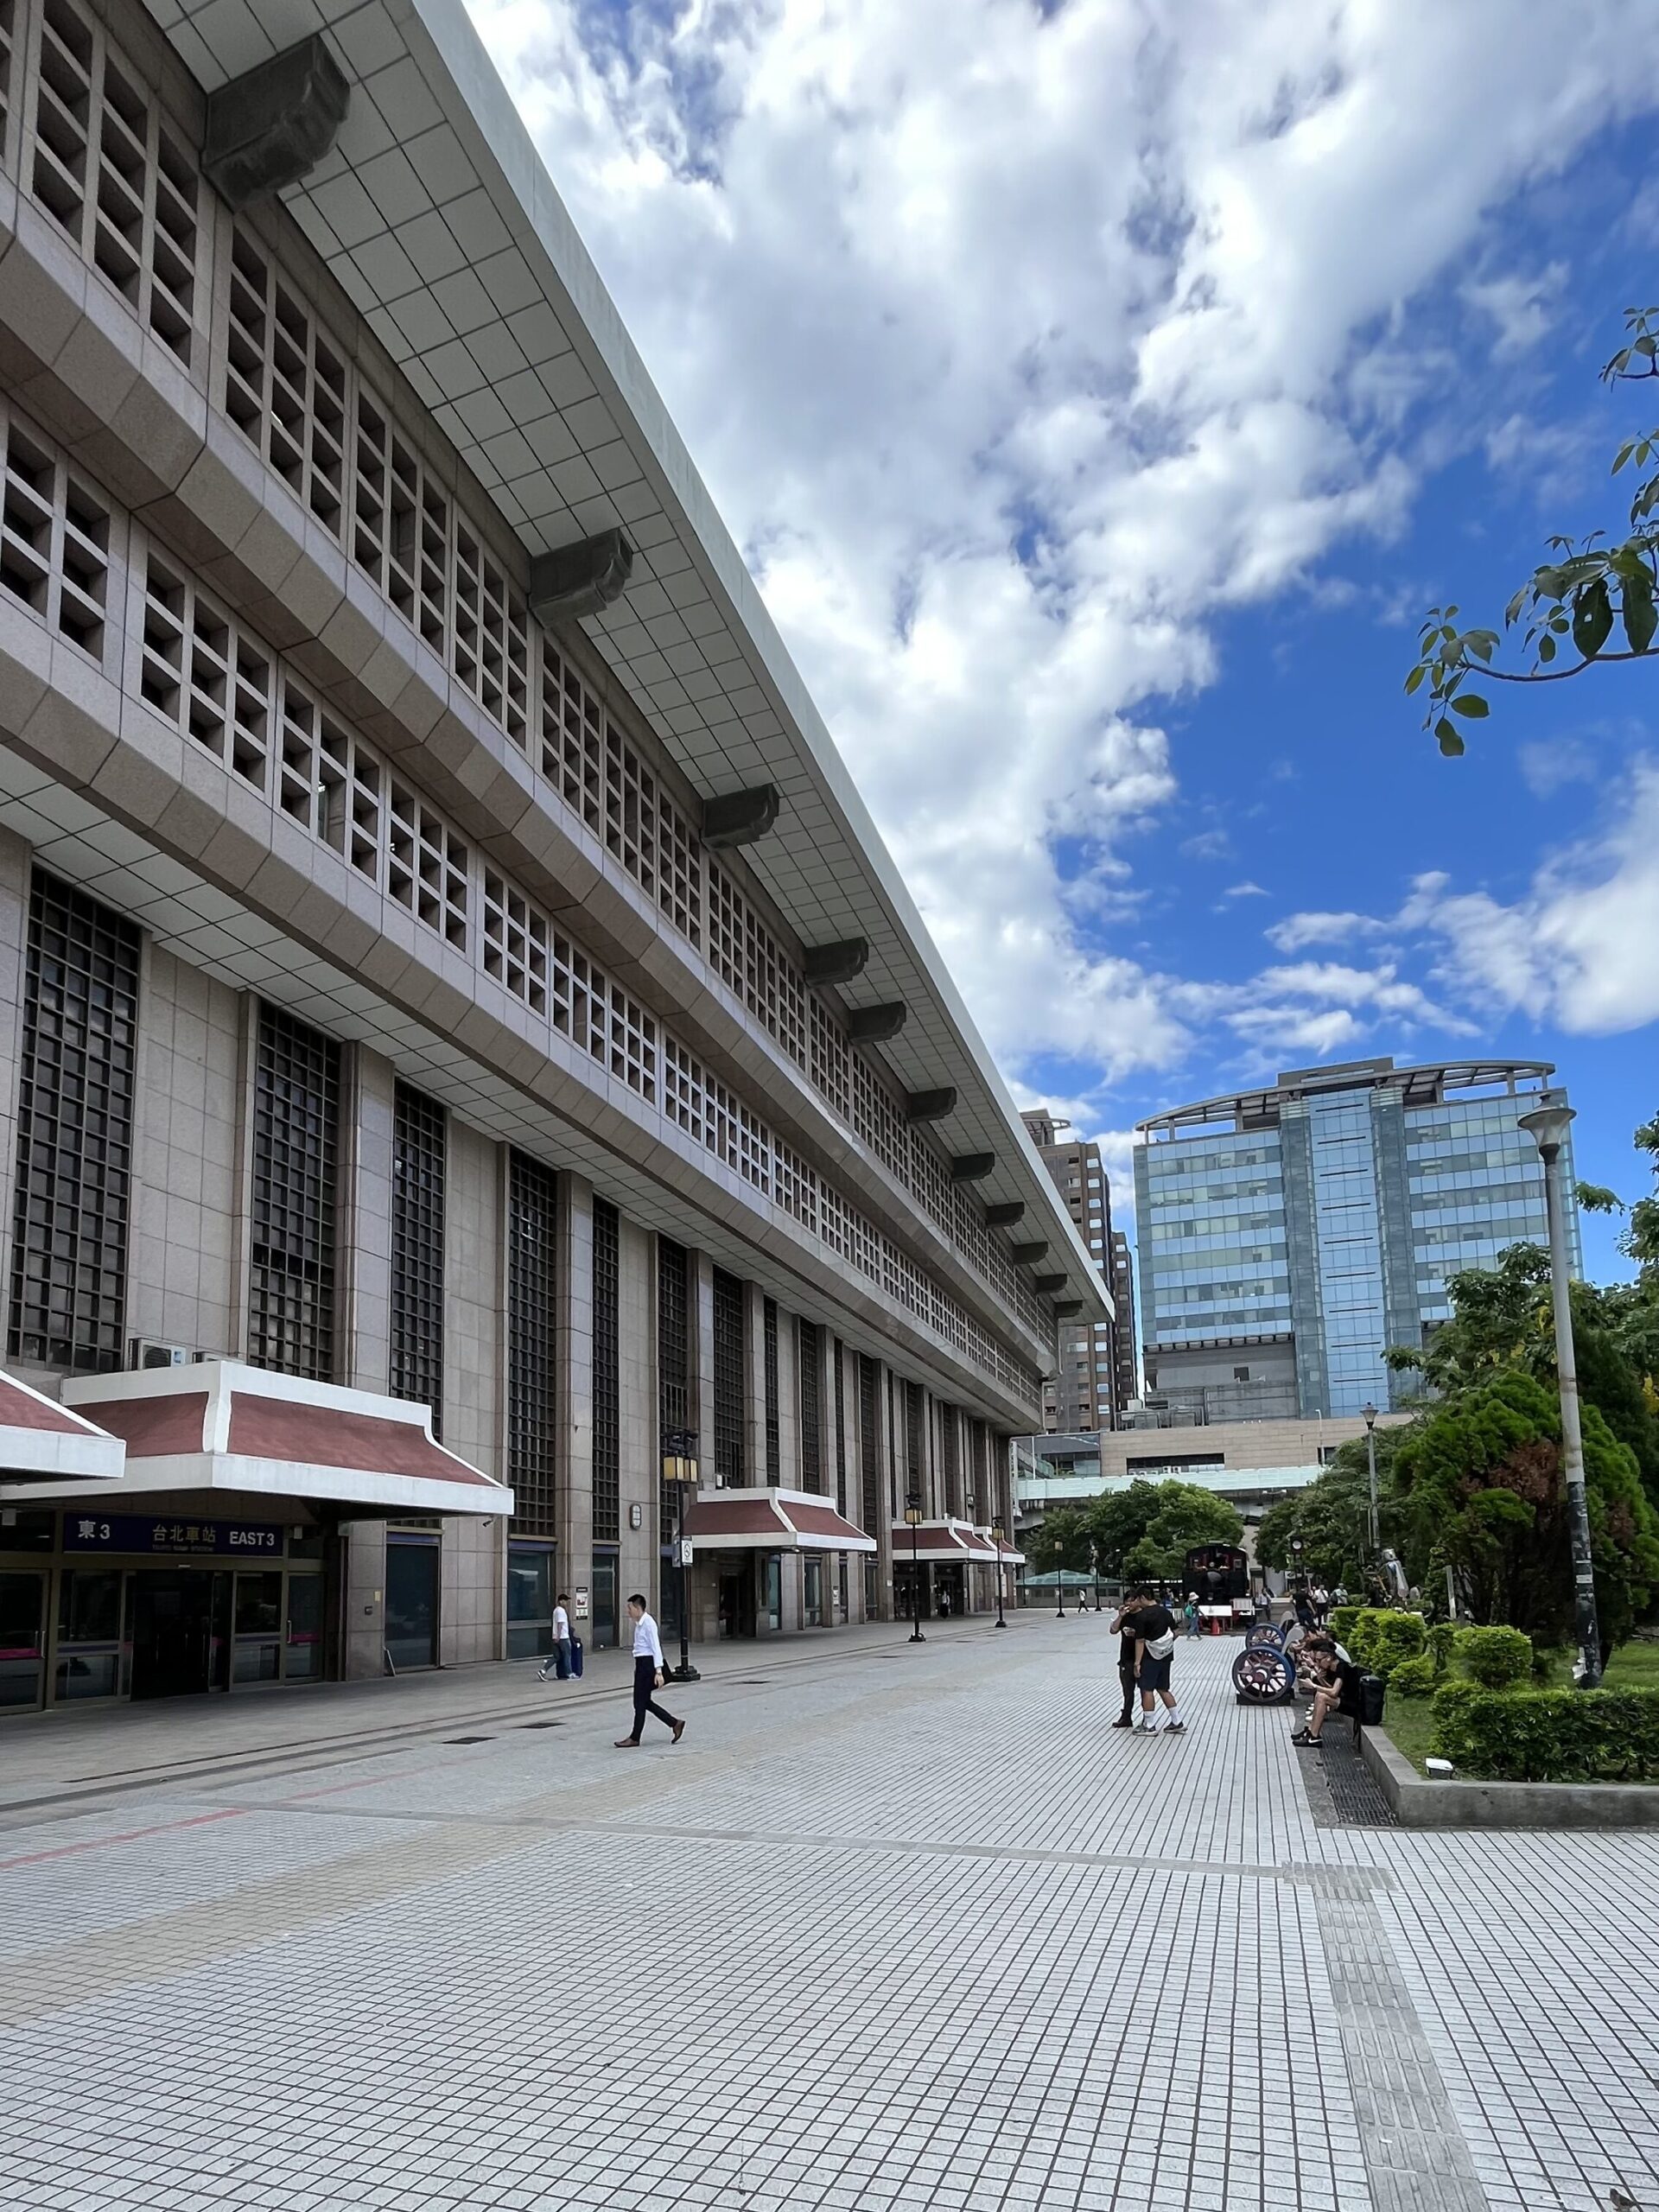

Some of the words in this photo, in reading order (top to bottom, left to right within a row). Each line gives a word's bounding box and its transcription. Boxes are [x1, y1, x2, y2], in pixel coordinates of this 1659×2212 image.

[152, 1523, 216, 1542] 台北車站
[229, 1531, 264, 1545] EAST
[266, 1533, 275, 1546] 3
